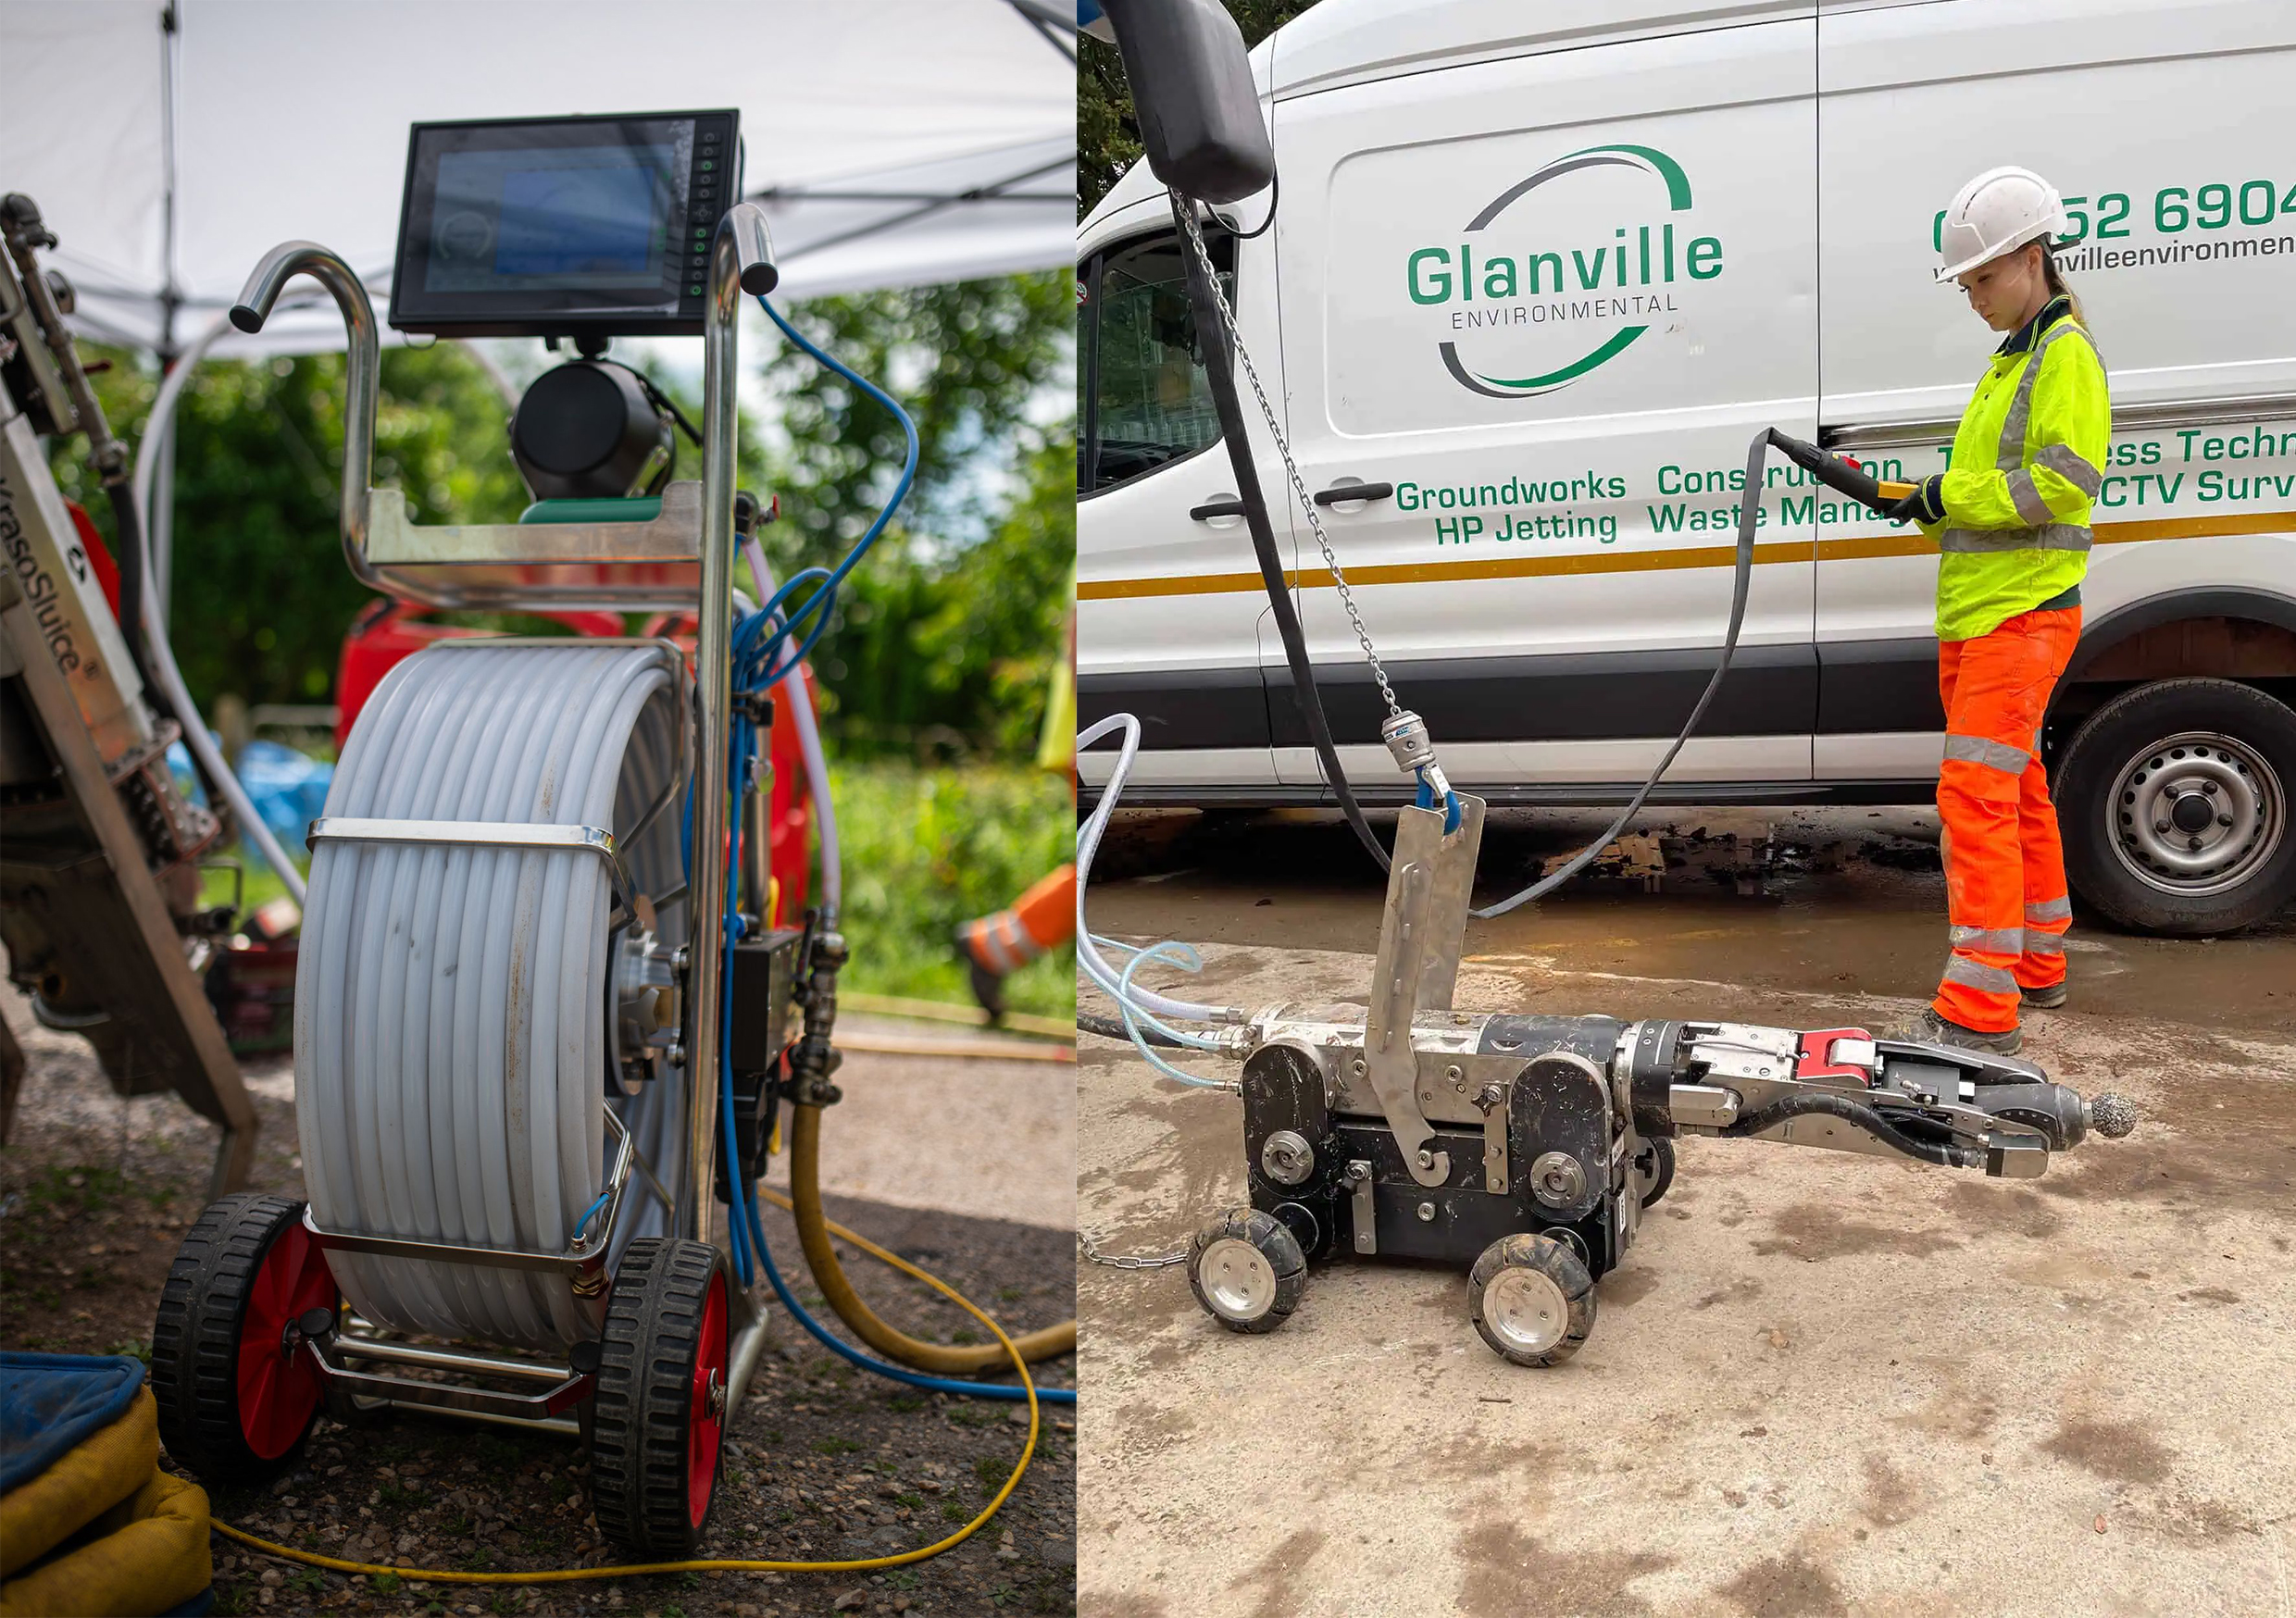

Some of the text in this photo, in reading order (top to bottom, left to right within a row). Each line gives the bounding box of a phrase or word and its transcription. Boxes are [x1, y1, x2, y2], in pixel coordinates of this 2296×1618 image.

[1408, 224, 1723, 305] Glanville
[1452, 292, 1678, 330] ENVIRONMENTAL
[1396, 470, 1626, 511] Groundworks
[1435, 516, 1483, 545] HP
[1495, 514, 1616, 543] Jetting
[1647, 504, 1766, 533] Waste
[2094, 473, 2184, 507] CTV
[2197, 470, 2295, 502] Surv
